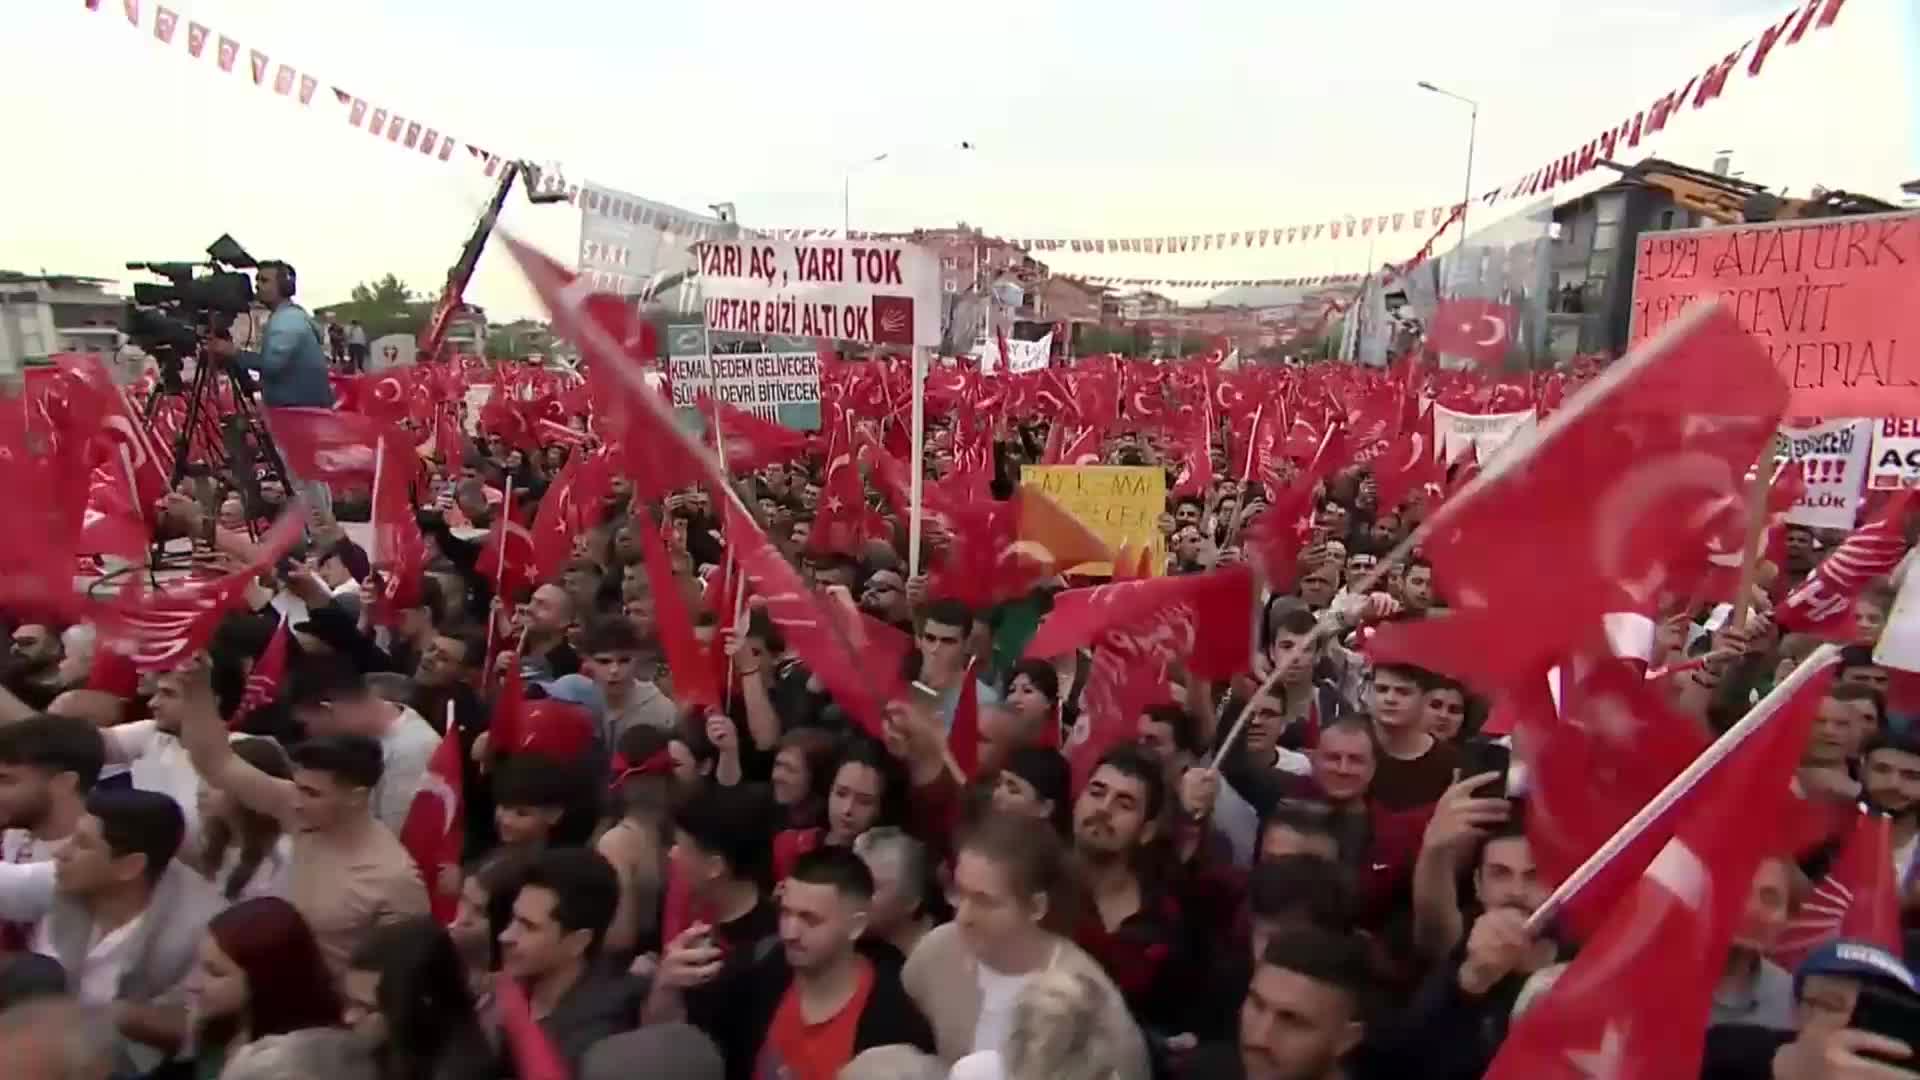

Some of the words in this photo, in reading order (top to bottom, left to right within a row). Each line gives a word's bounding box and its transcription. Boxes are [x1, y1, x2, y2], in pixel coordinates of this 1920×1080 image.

[698, 243, 741, 278] YARI
[749, 246, 777, 288] AÇ
[794, 247, 843, 283] YARI
[852, 248, 903, 285] TOK
[1712, 218, 1906, 278] ATATÜRK
[764, 293, 796, 335] BİZİ
[802, 303, 837, 338] ALTI
[843, 305, 869, 341] OK
[1719, 275, 1847, 337] CEVİT
[712, 357, 753, 379] DEDEM
[720, 380, 756, 402] DEVRİ
